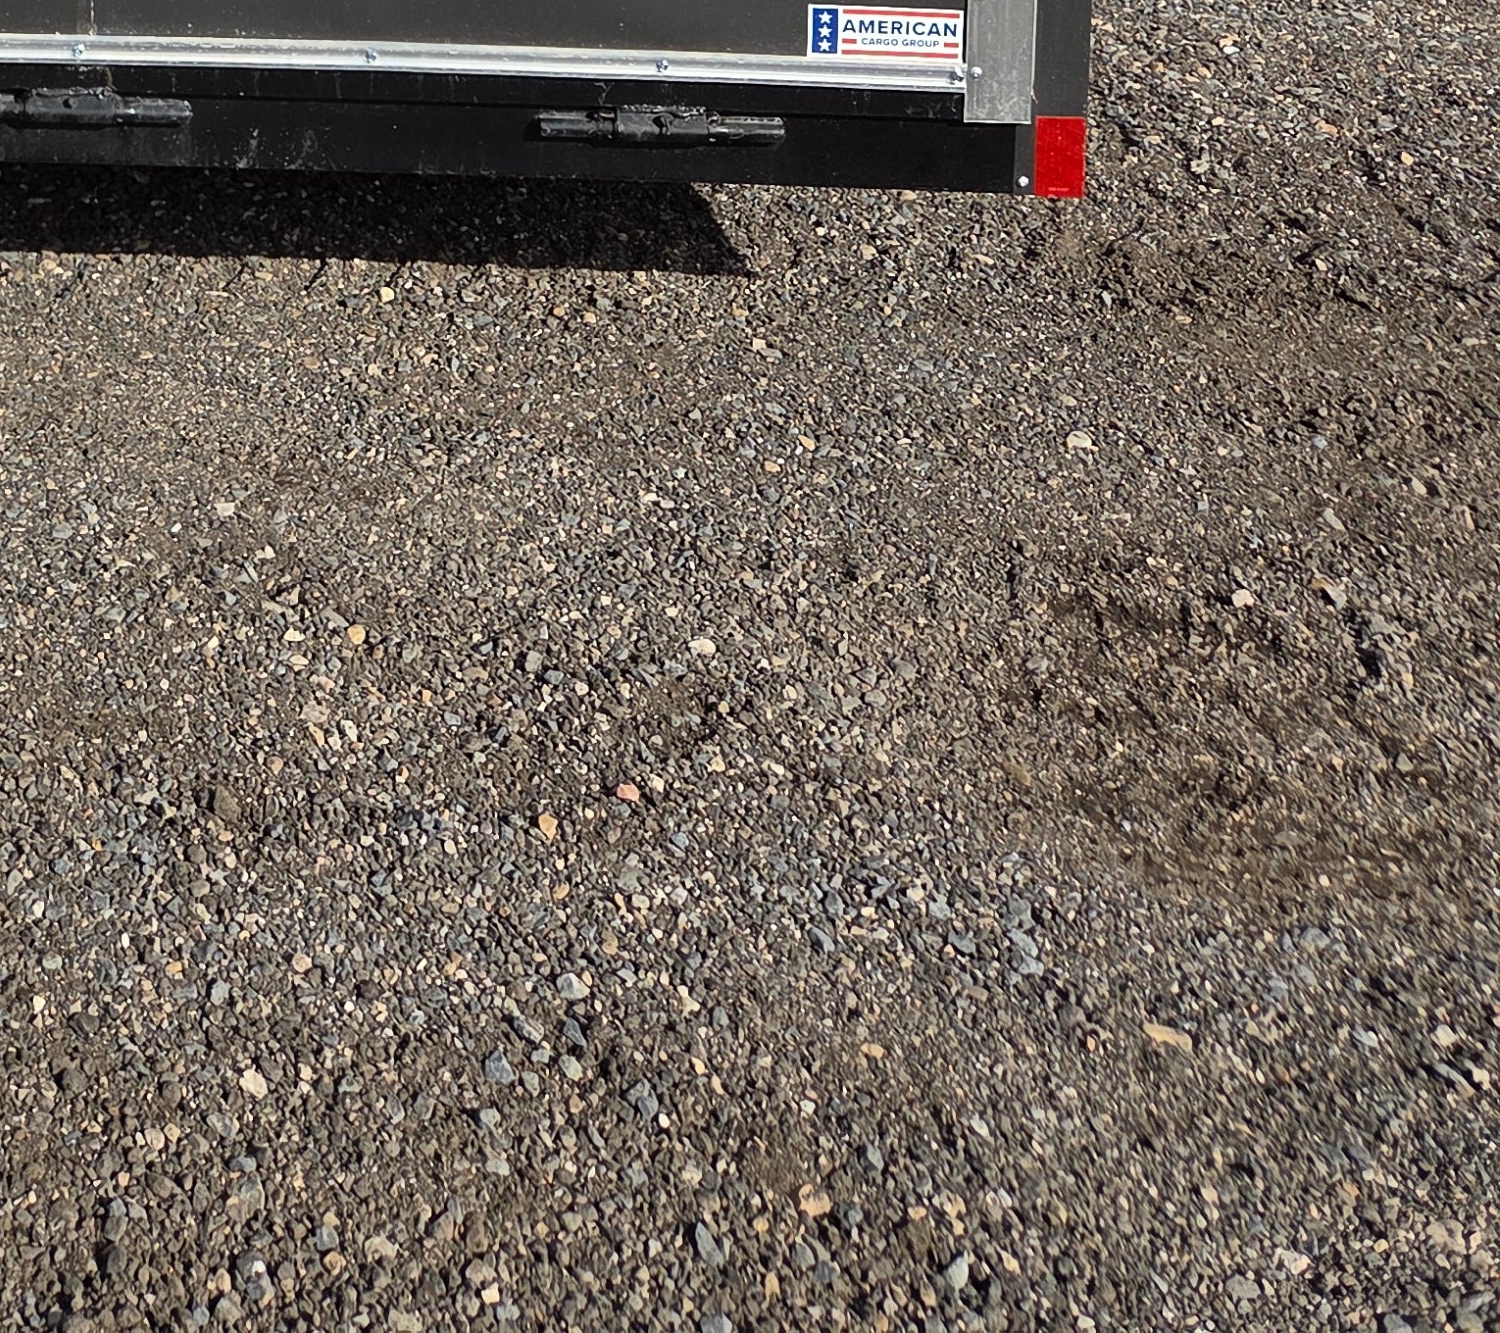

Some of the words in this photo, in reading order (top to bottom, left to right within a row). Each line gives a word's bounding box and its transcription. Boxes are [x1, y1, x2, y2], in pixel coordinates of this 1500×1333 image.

[842, 19, 958, 38] AMERICAN
[861, 37, 898, 47] CARGO
[902, 39, 940, 48] GROUP
